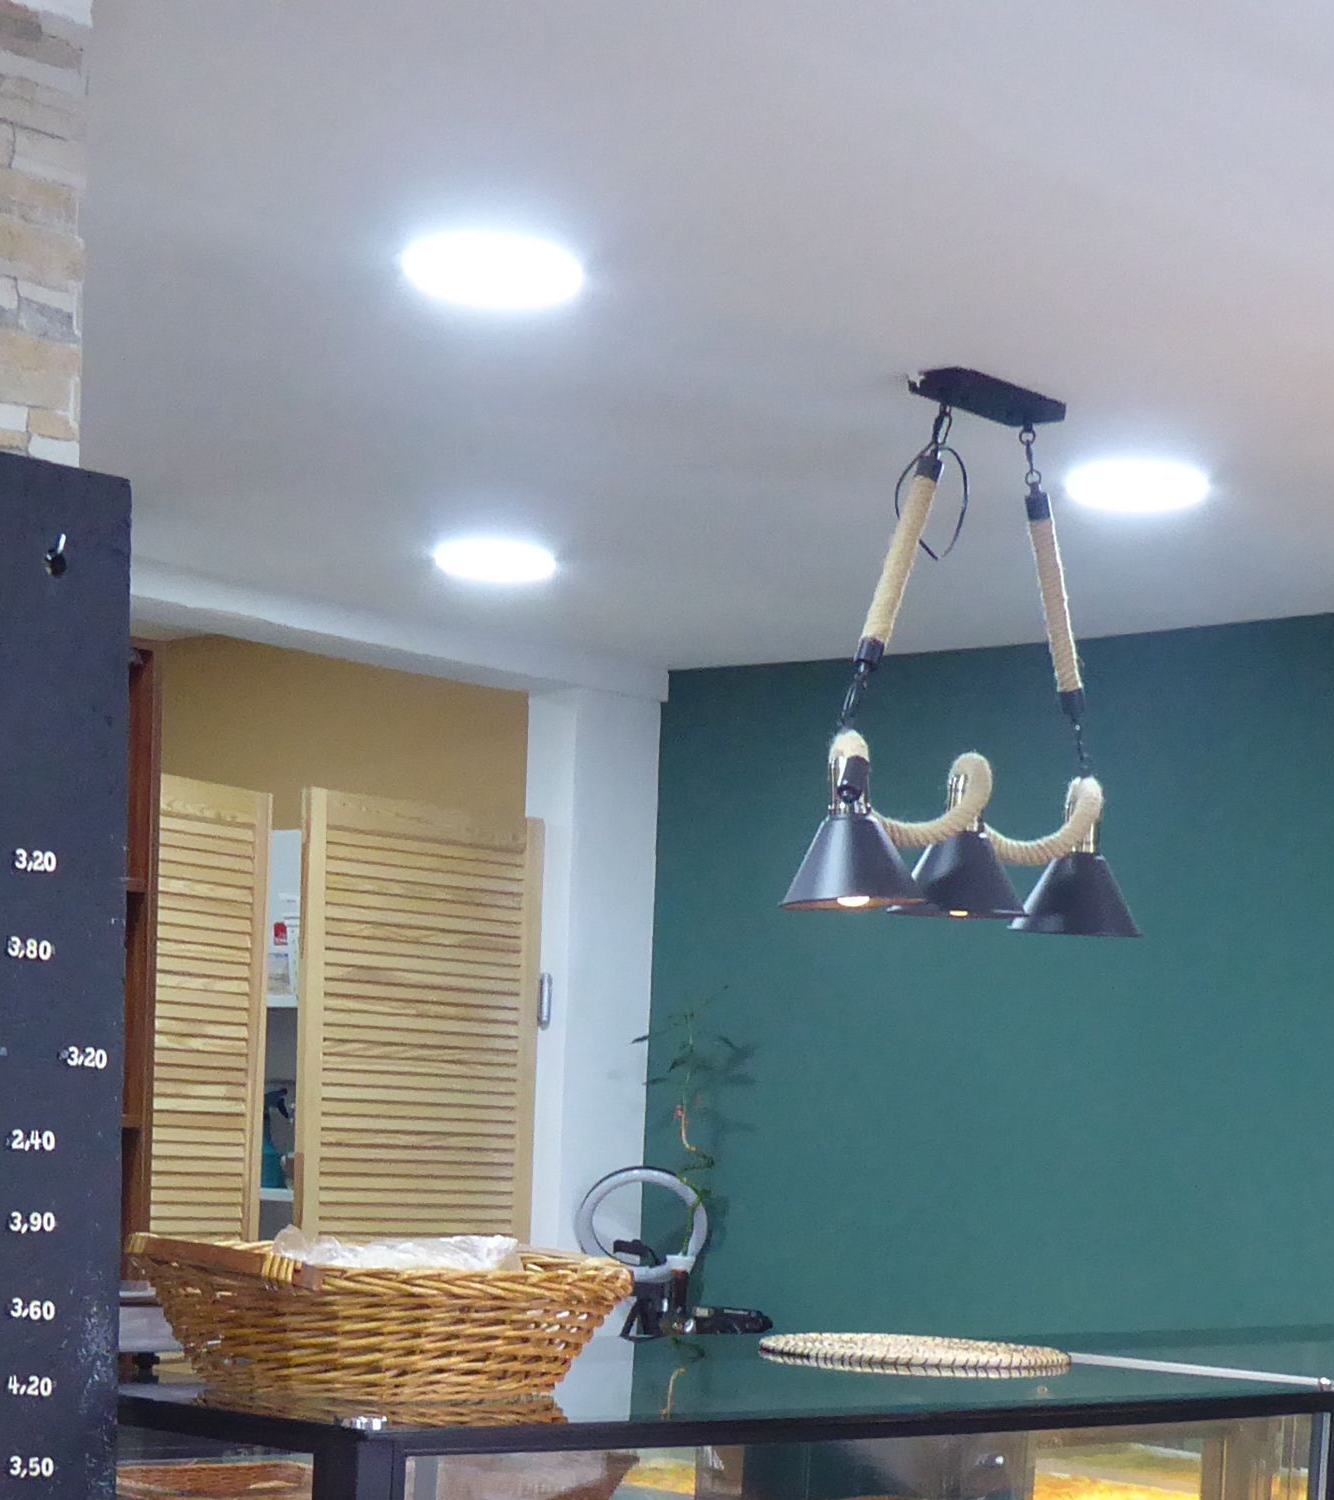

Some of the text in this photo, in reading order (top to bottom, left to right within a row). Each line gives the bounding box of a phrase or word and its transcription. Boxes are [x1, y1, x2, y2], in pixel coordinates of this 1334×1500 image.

[14, 848, 57, 873] 3,20
[7, 936, 54, 961] 3,80
[66, 1046, 109, 1070] 3,20
[10, 1129, 56, 1152] 2,40
[9, 1211, 57, 1234] 3,90
[10, 1298, 56, 1321] 3,60
[7, 1374, 54, 1397] 4,20
[9, 1455, 55, 1478] 3,50
